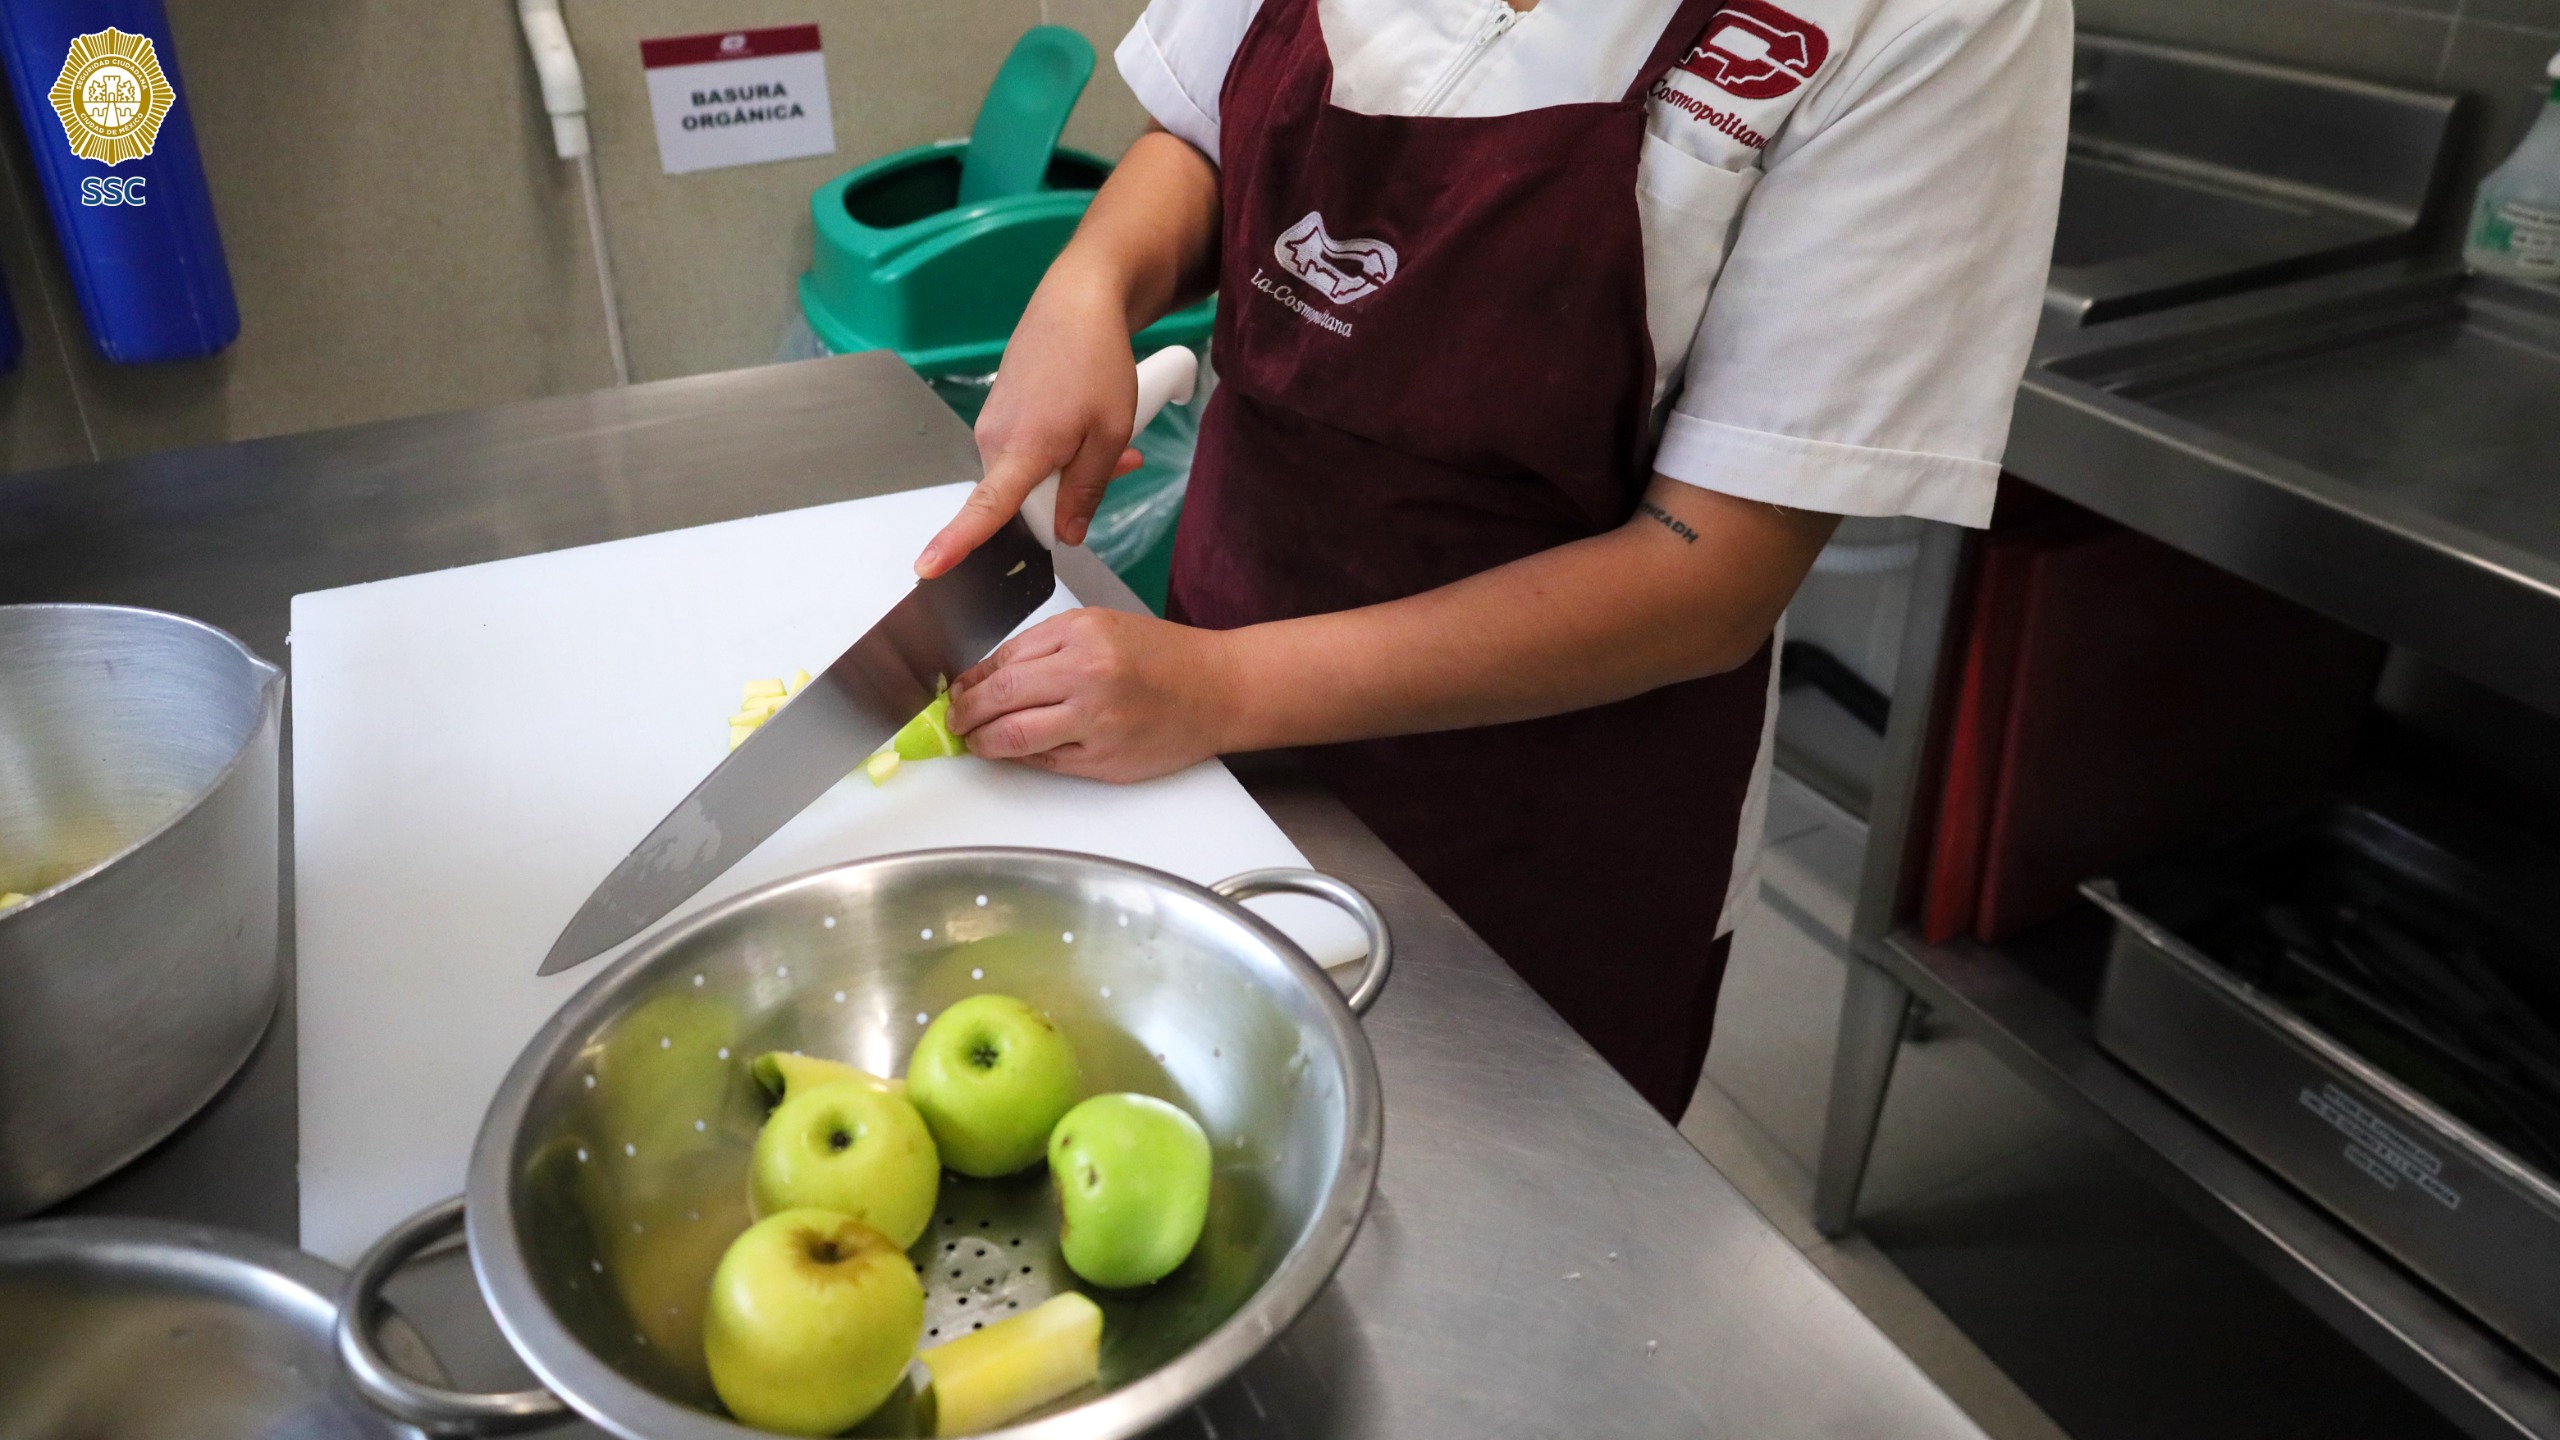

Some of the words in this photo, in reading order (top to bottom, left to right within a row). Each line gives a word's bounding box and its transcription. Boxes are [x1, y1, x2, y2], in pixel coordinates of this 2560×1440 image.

[691, 82, 787, 106] BASURA
[682, 103, 804, 131] ORGÁNICA
[1273, 285, 1353, 338] Cosmpltana
